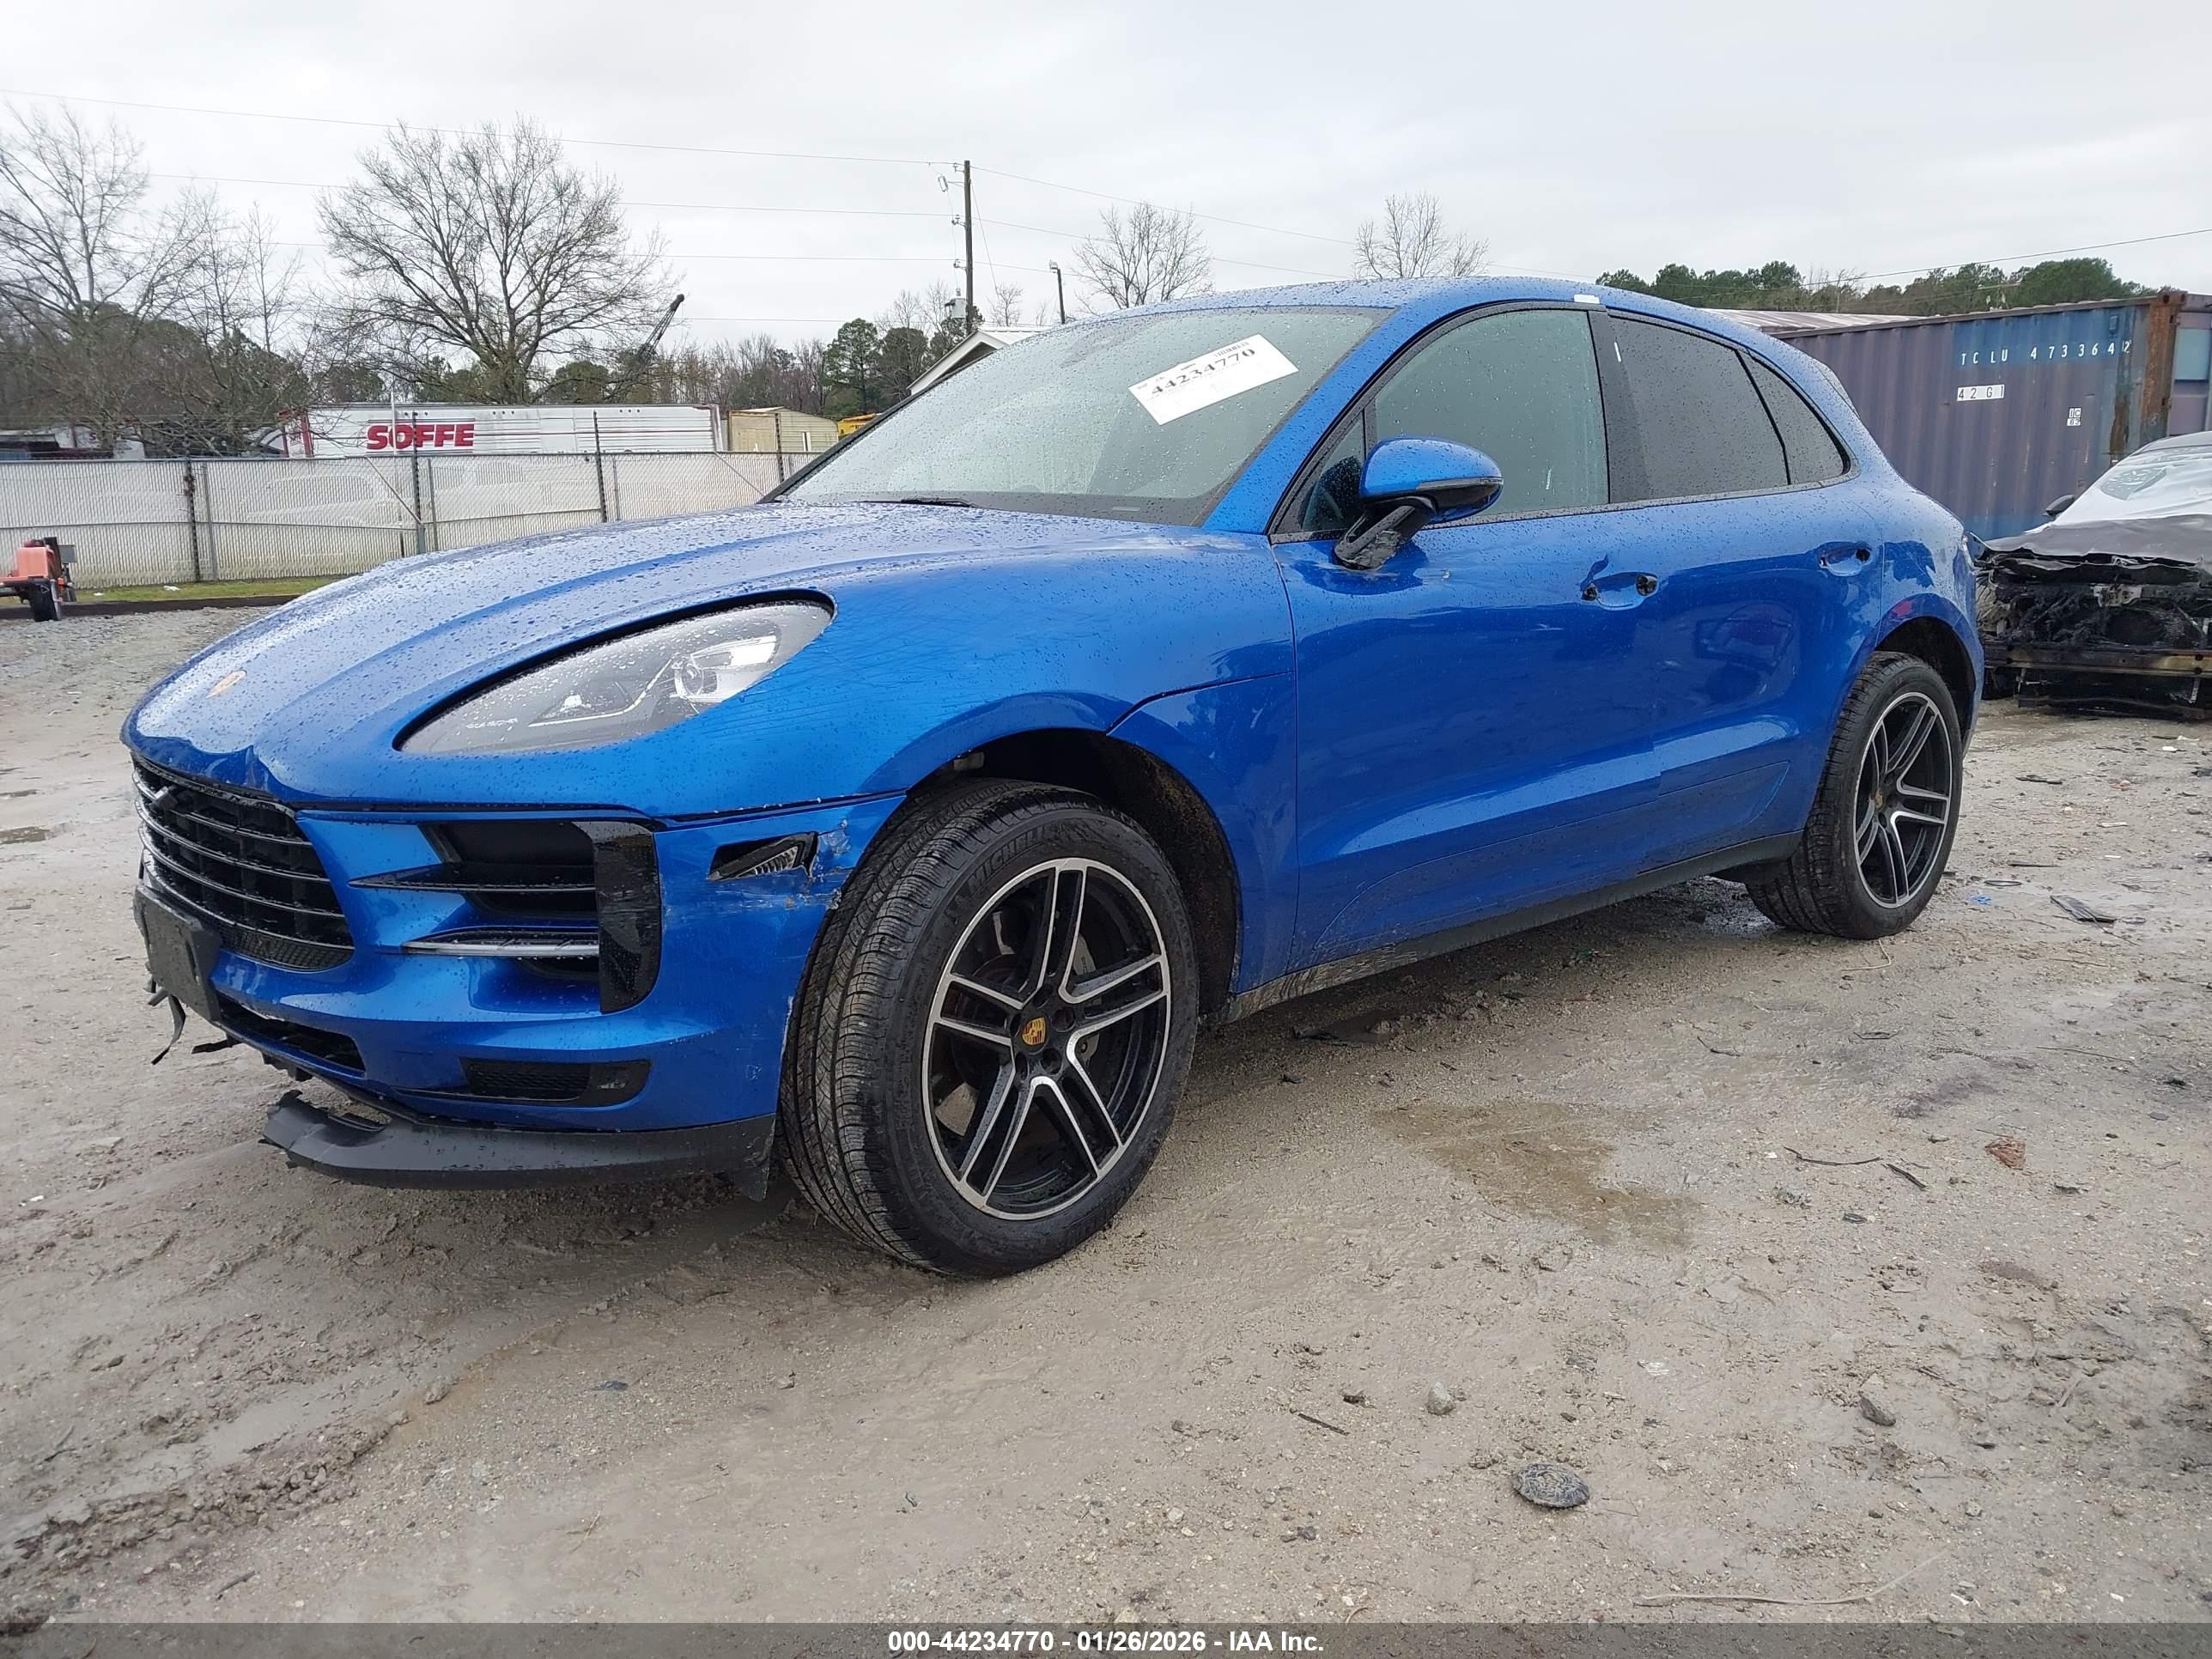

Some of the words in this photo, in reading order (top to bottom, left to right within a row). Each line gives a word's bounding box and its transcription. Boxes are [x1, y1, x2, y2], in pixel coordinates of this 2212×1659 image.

[1961, 349, 2008, 366] TCLU
[1152, 349, 1256, 395] 44234770
[366, 424, 475, 451] SOFFE
